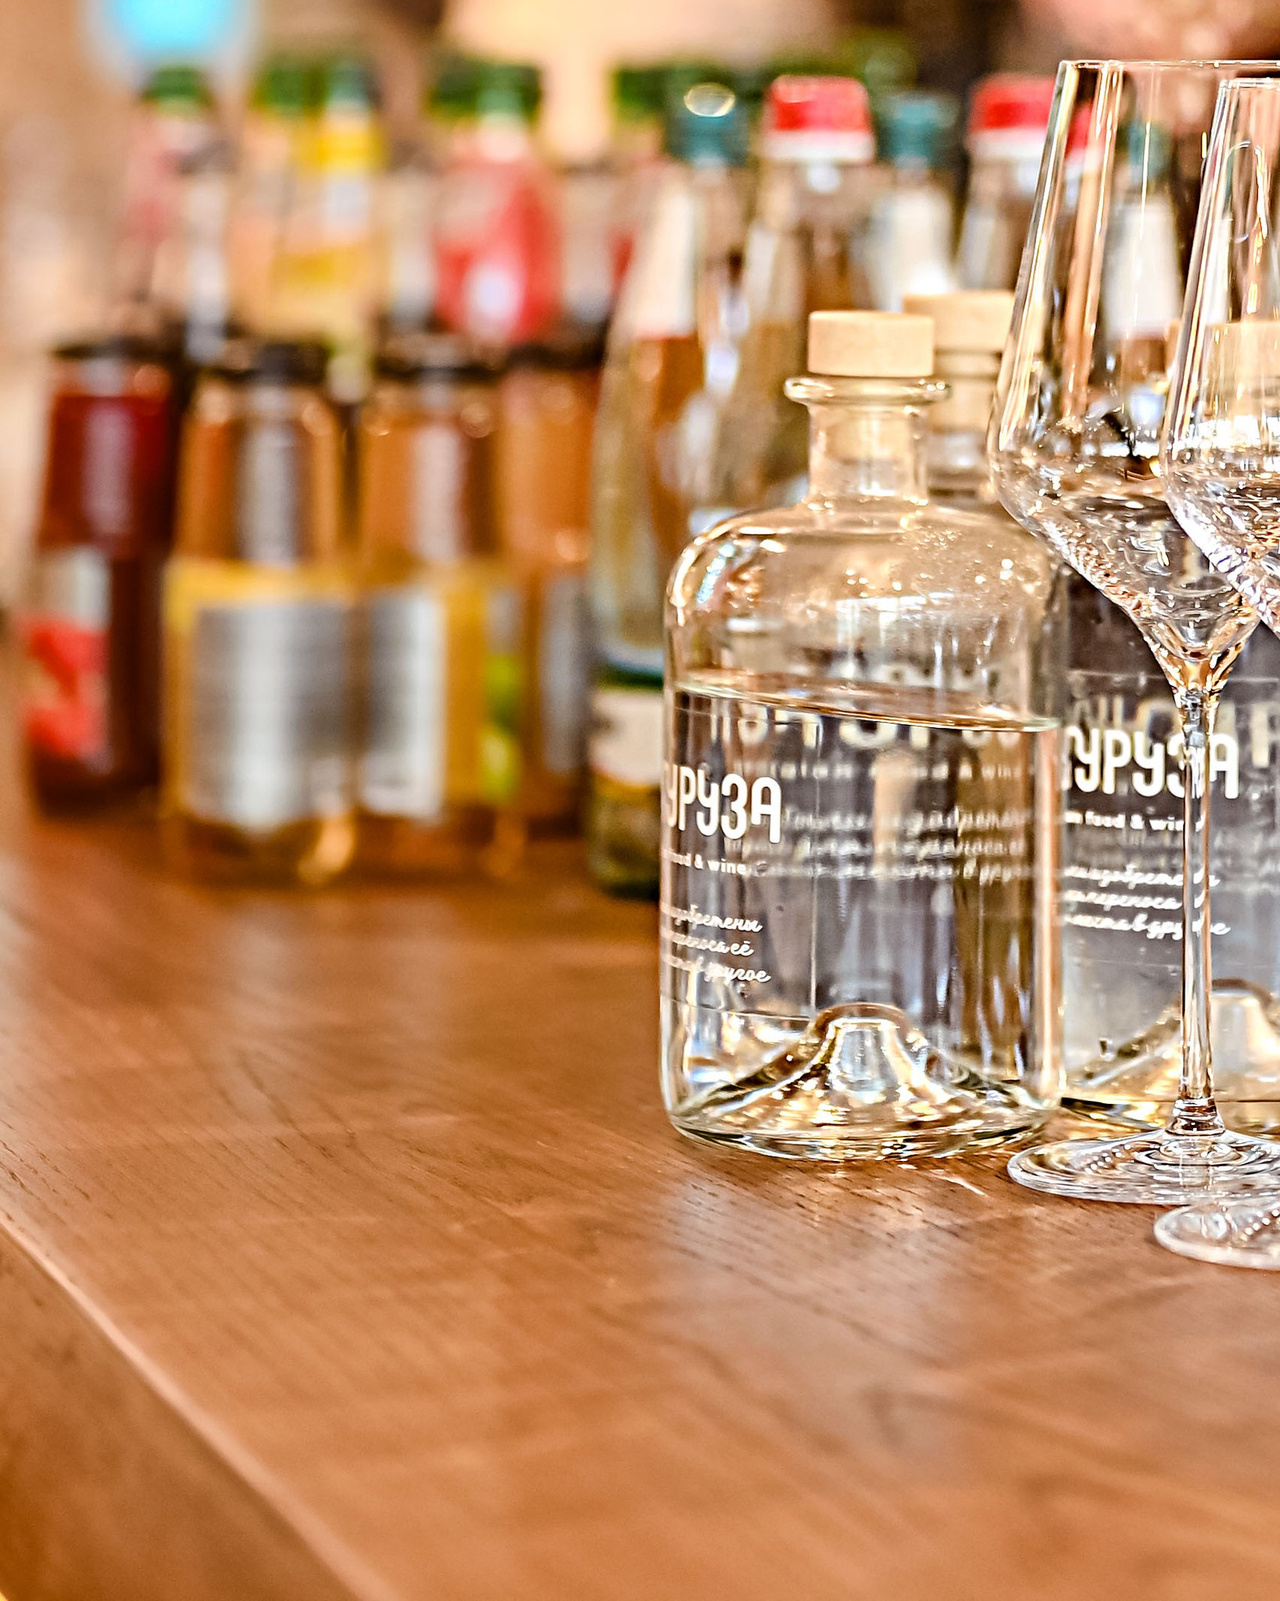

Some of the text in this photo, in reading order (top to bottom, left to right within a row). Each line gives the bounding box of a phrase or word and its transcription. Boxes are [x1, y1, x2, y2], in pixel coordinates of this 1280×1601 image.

[1085, 811, 1126, 829] food
[1130, 814, 1145, 830] &
[1150, 816, 1205, 832] win
[694, 853, 704, 870] &
[707, 857, 748, 875] wine
